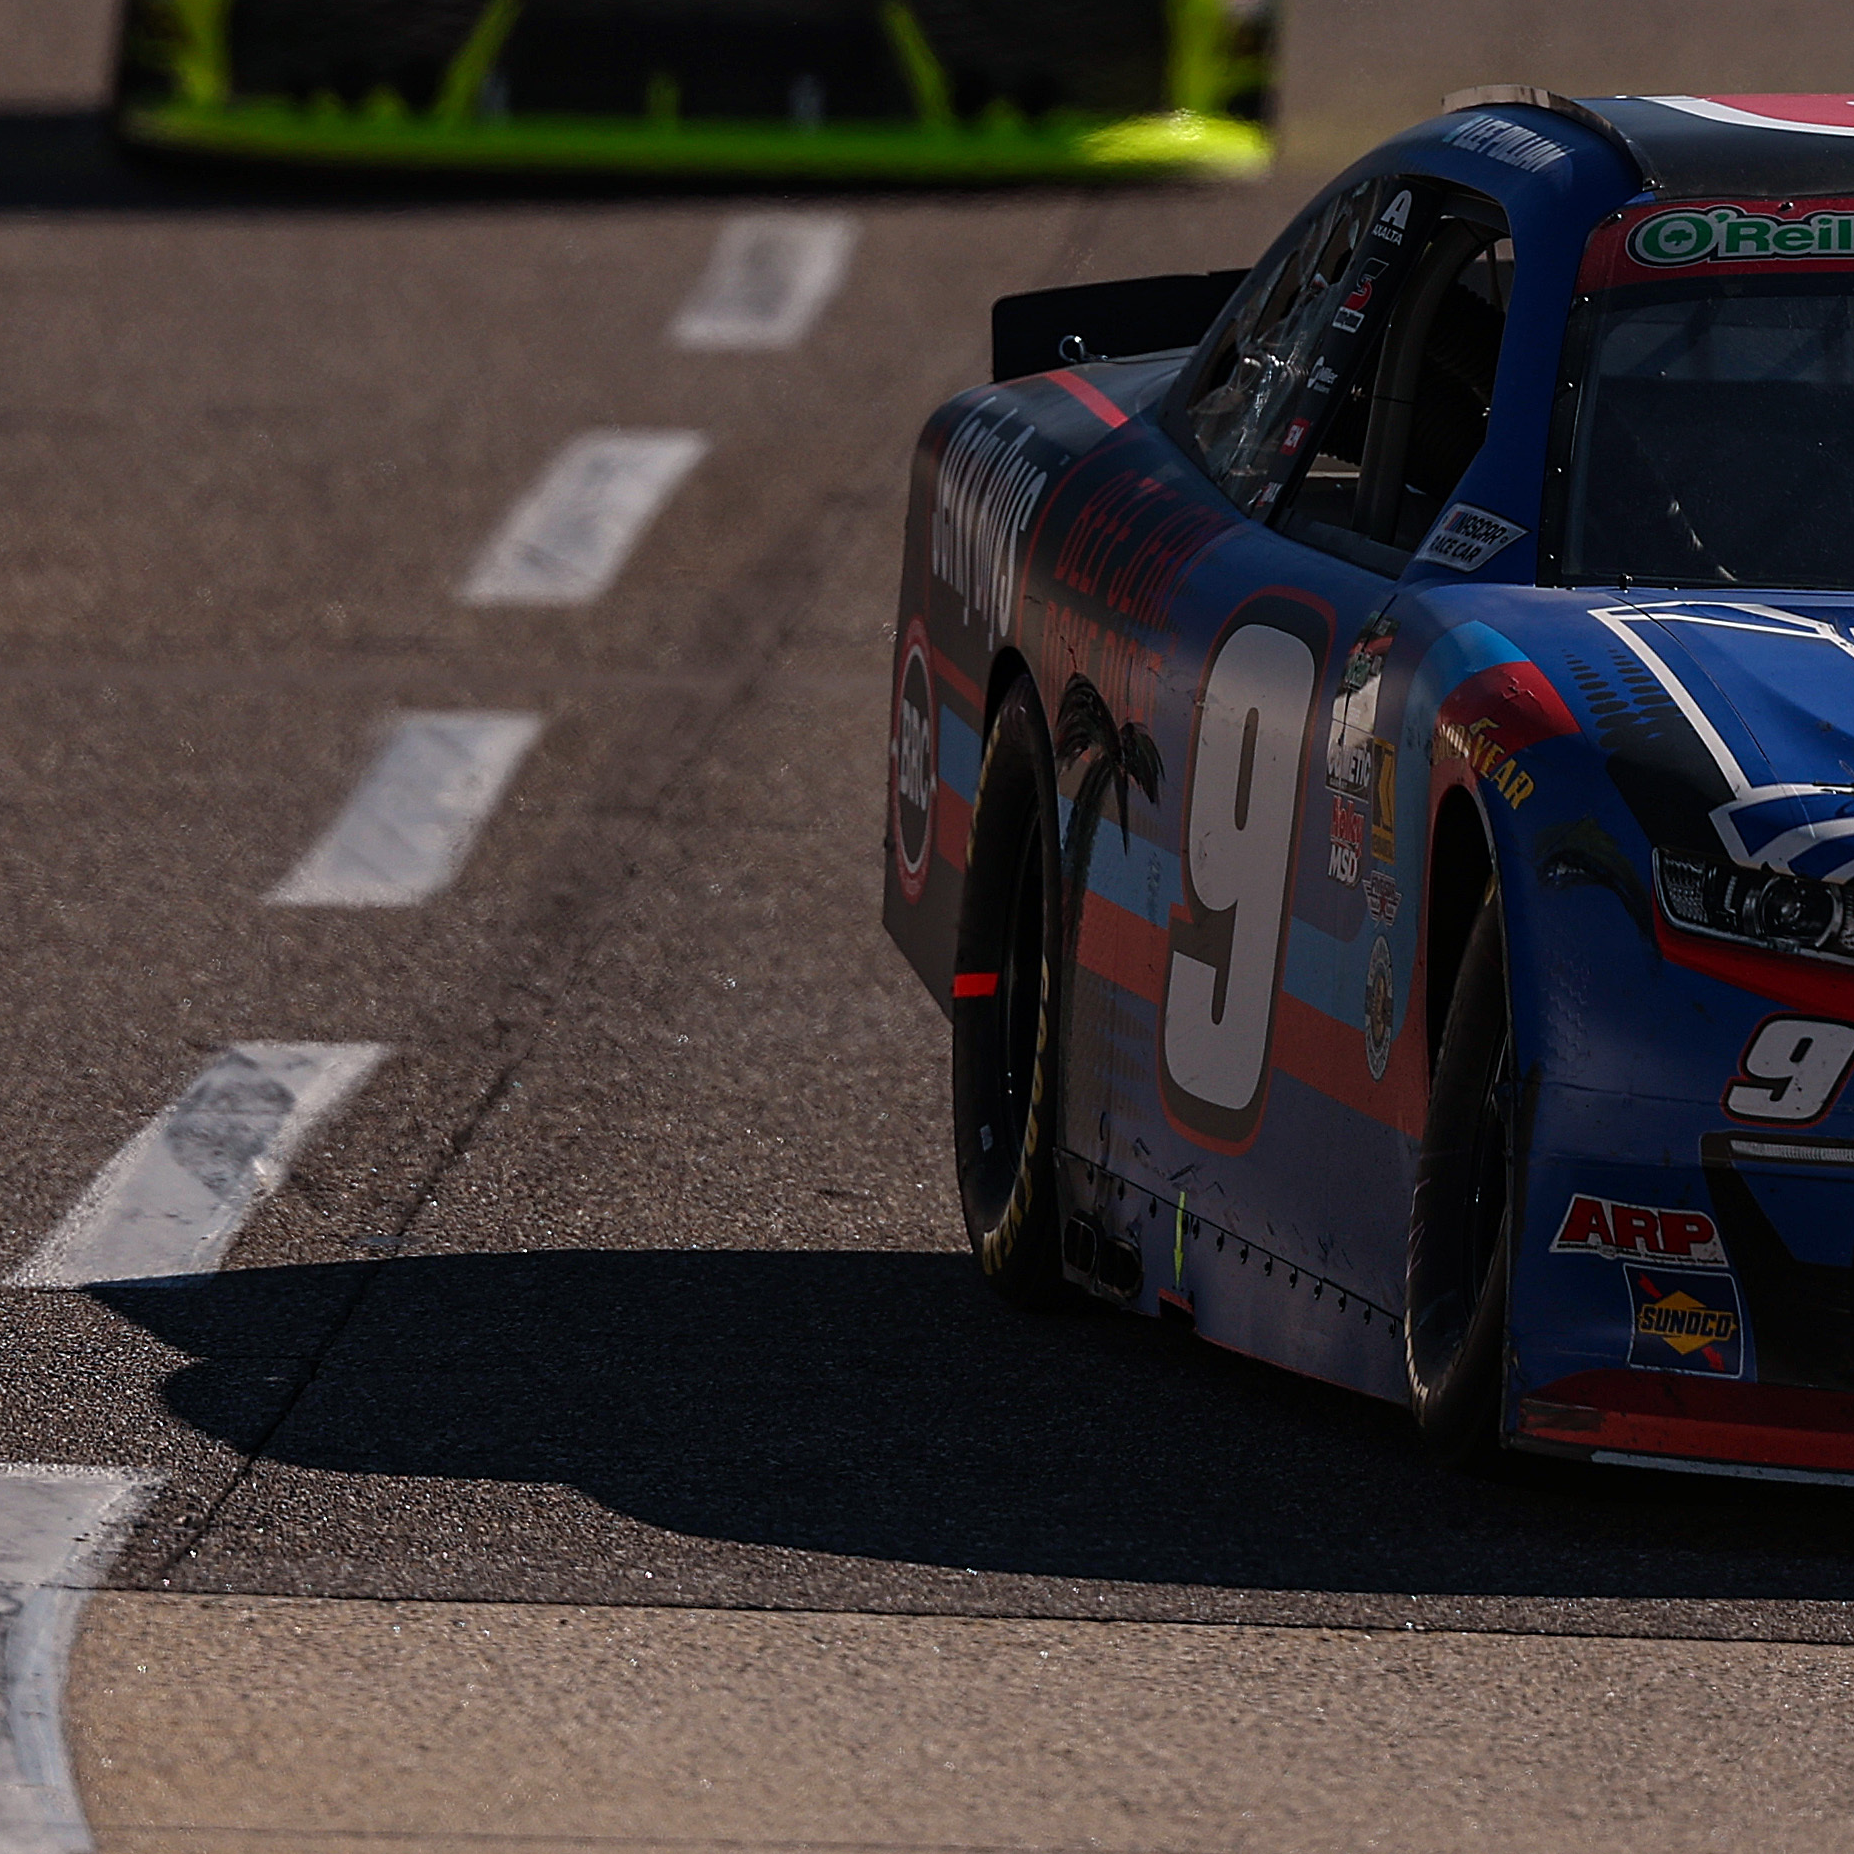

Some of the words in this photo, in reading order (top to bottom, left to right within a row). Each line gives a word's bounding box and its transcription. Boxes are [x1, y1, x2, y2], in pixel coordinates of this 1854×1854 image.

[1455, 512, 1507, 545] NASCAR
[1450, 542, 1482, 562] CAR
[1164, 622, 1316, 1111] 9
[1327, 844, 1361, 891] MSD
[1558, 1197, 1715, 1256] ARP
[1641, 1306, 1731, 1338] SUNOCO
